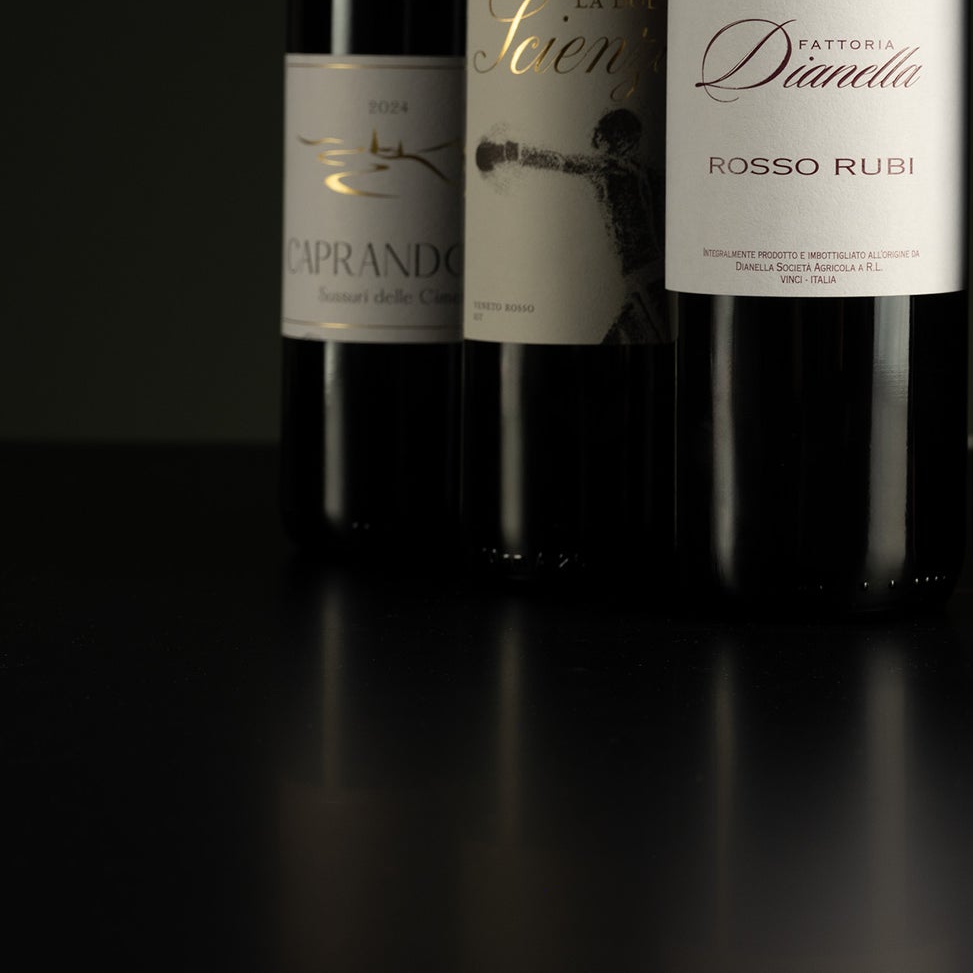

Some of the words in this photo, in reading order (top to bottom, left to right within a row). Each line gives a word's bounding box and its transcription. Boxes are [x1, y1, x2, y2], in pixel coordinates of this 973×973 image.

[799, 39, 895, 50] FATTORIA
[695, 18, 923, 103] Dianella
[368, 99, 409, 115] 2024
[708, 157, 820, 176] ROSSO
[834, 157, 914, 176] RUBI
[286, 236, 464, 278] CAPRANDO
[758, 251, 797, 260] PRODOTTO
[800, 252, 805, 260] E
[808, 251, 866, 260] IMBOTTIGLIATO
[780, 275, 802, 284] VINCI
[810, 275, 836, 284] ITALIA
[373, 287, 412, 305] delle
[504, 303, 535, 313] ROSSO
